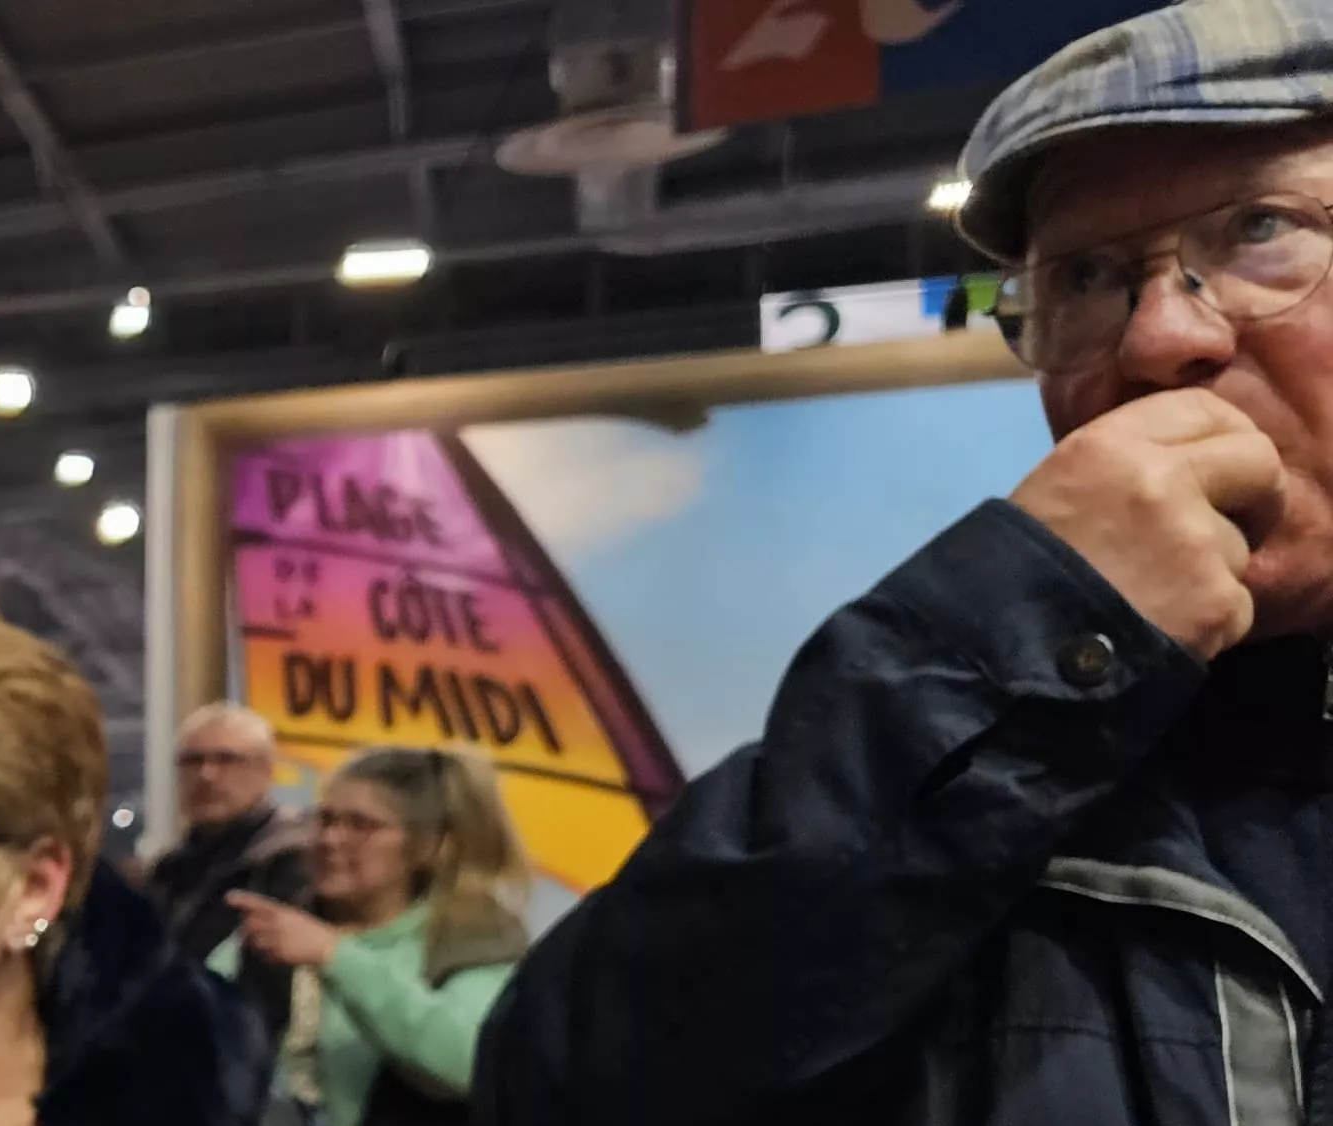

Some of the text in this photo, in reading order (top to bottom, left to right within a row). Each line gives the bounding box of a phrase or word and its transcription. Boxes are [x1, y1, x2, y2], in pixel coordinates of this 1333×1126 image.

[265, 468, 447, 548] PLAGE
[367, 566, 501, 654] CÔTE
[283, 652, 562, 757] DU MIDI
